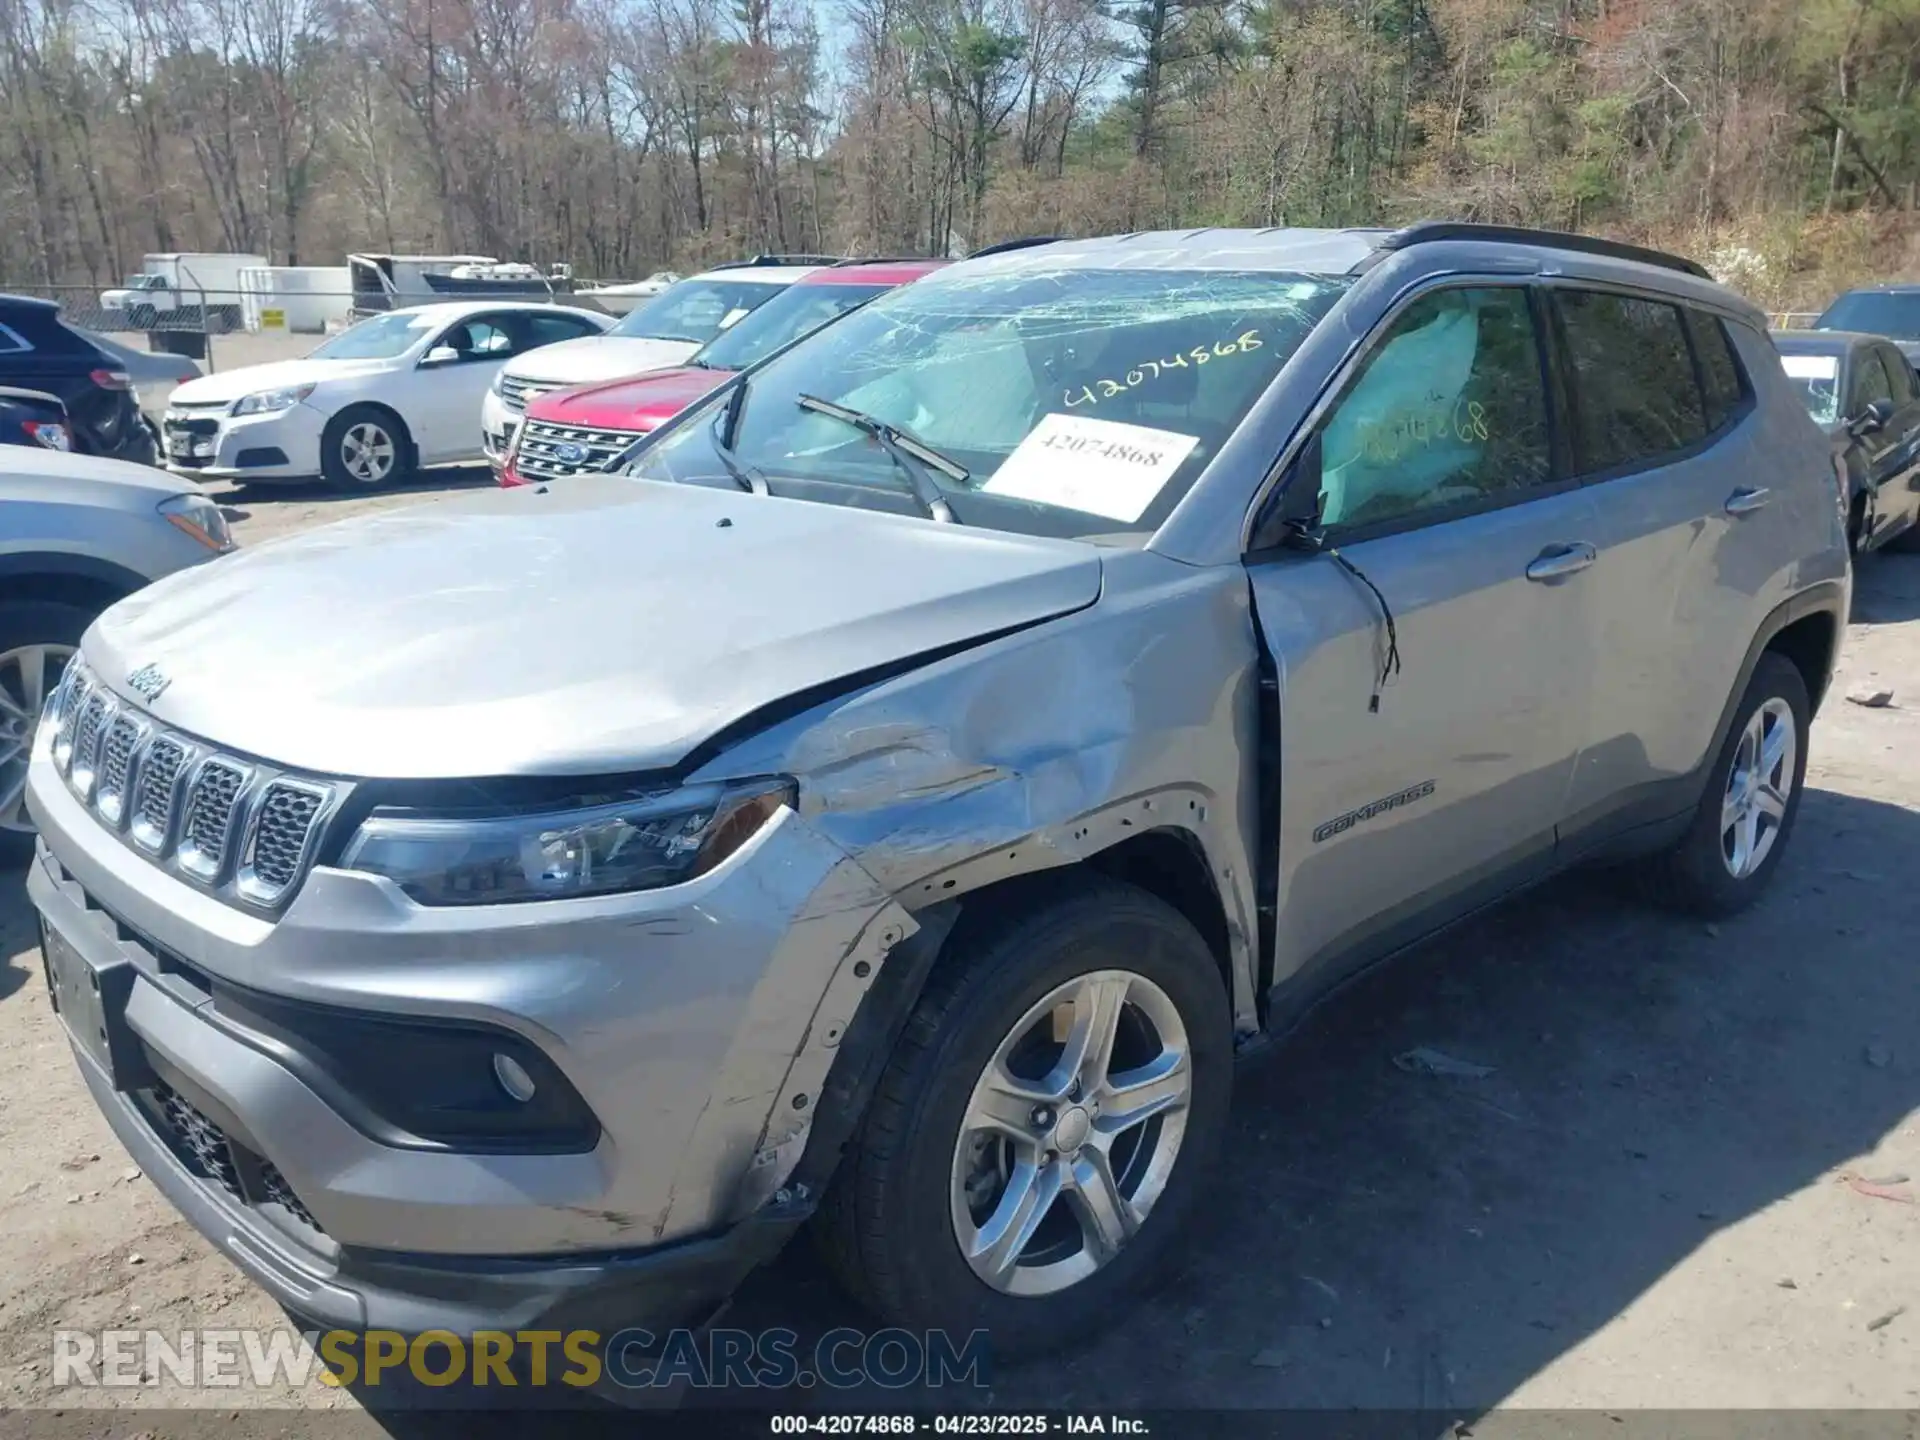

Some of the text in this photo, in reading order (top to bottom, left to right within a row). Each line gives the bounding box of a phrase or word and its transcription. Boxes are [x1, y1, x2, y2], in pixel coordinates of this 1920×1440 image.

[1063, 329, 1263, 408] 42074868
[1040, 432, 1164, 467] 42074868
[1311, 779, 1439, 844] COMPASS
